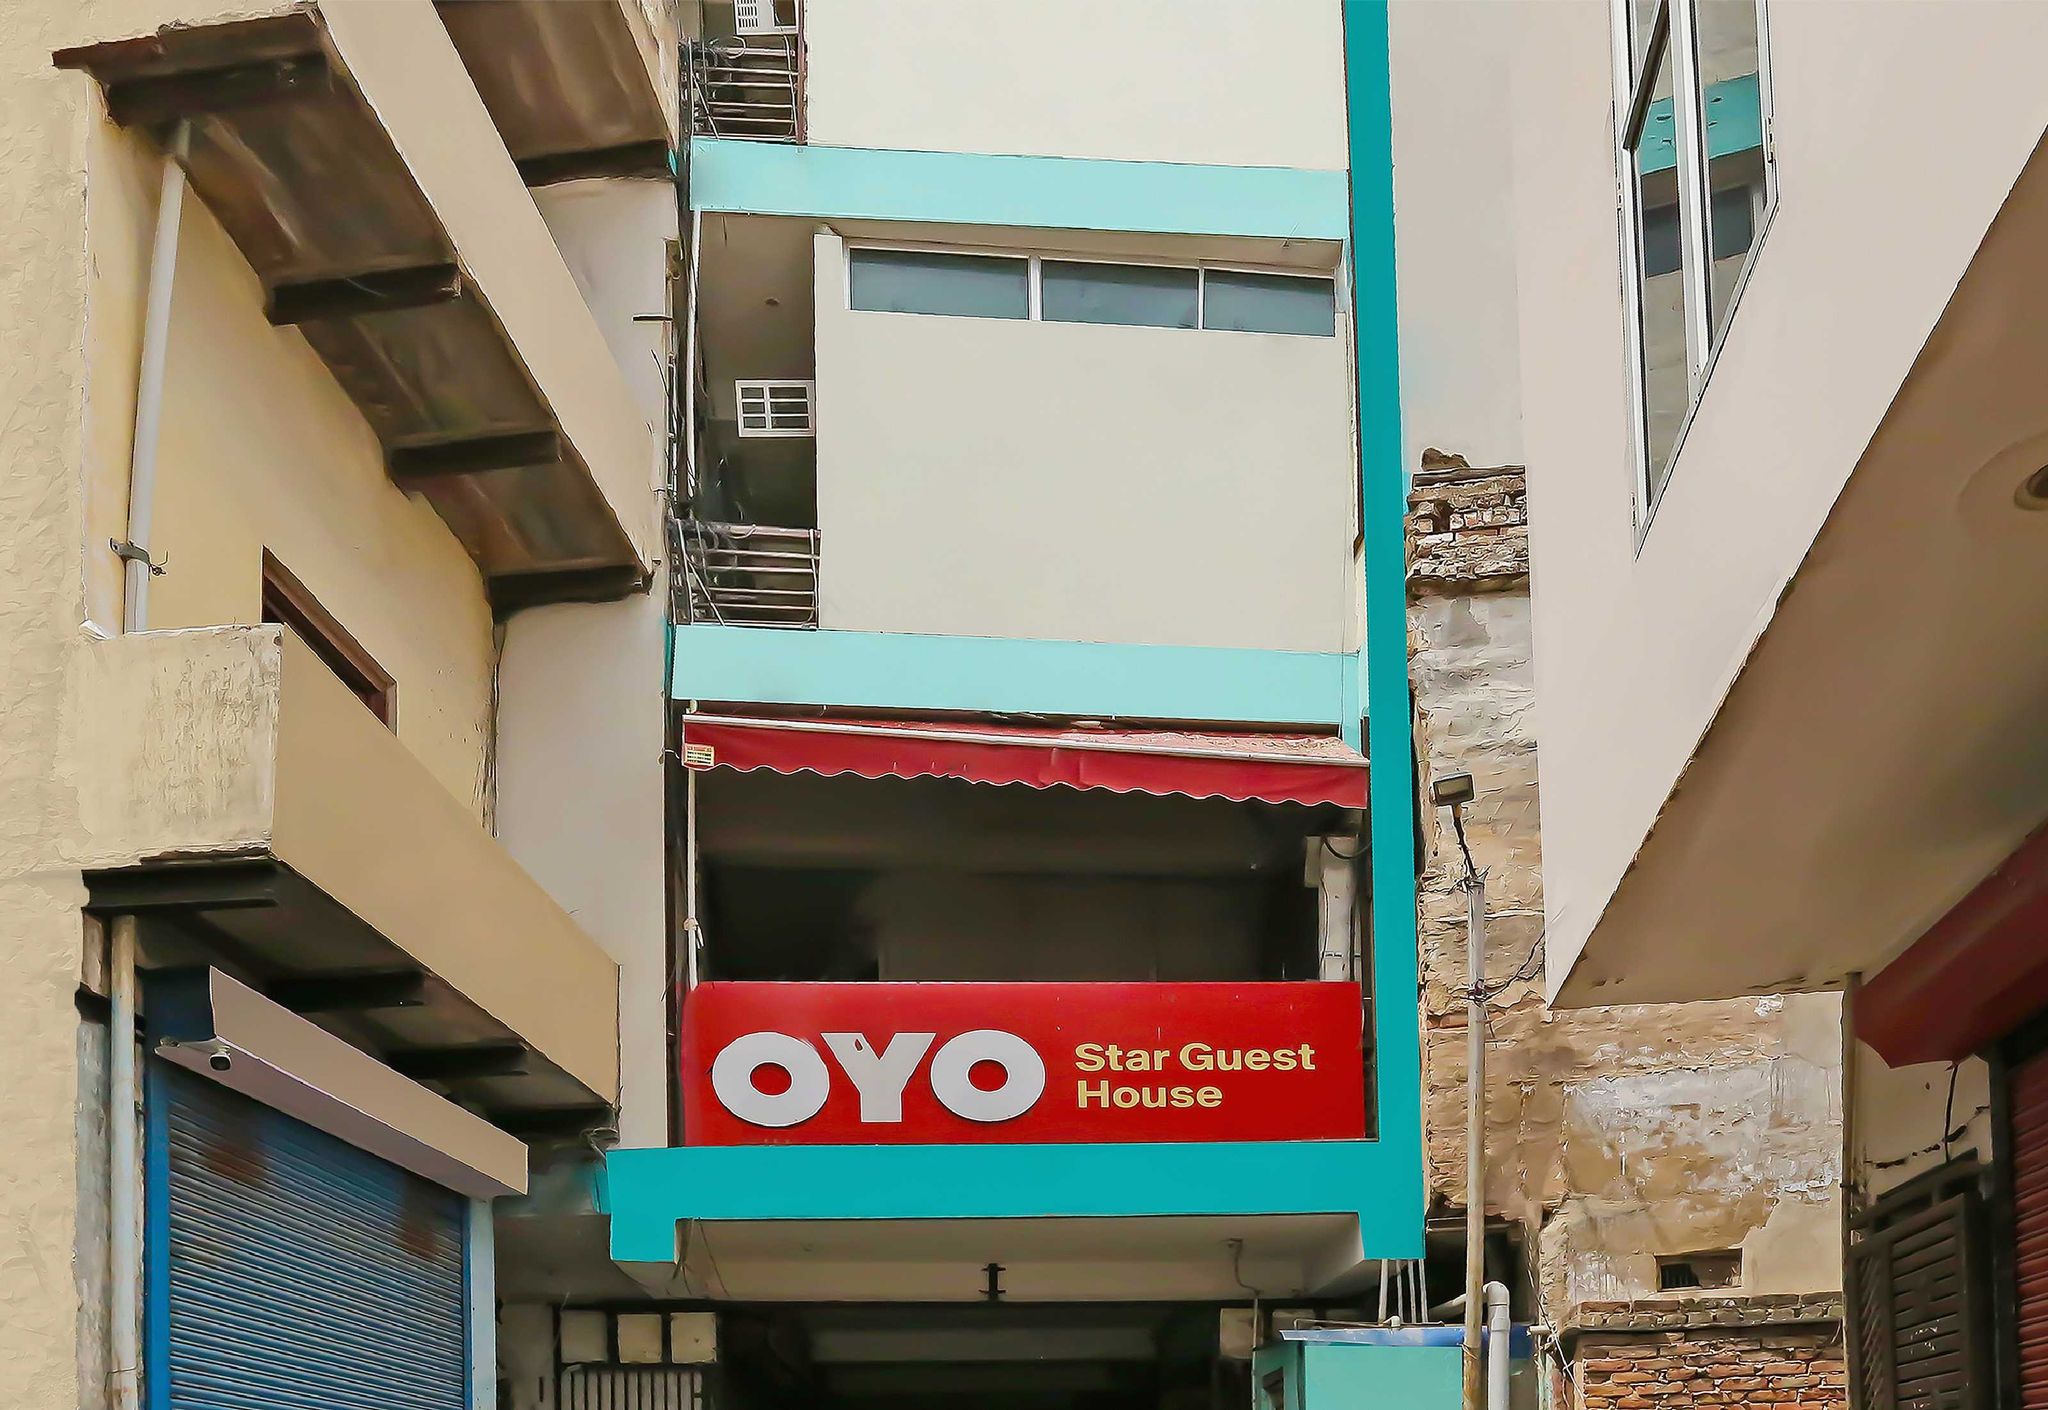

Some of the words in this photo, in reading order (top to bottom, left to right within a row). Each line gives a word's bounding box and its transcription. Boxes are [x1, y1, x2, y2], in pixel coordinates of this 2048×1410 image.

[1075, 1043, 1170, 1071] Star
[1179, 1042, 1315, 1071] Guest
[712, 1030, 1046, 1127] OYO
[1077, 1080, 1223, 1108] House
